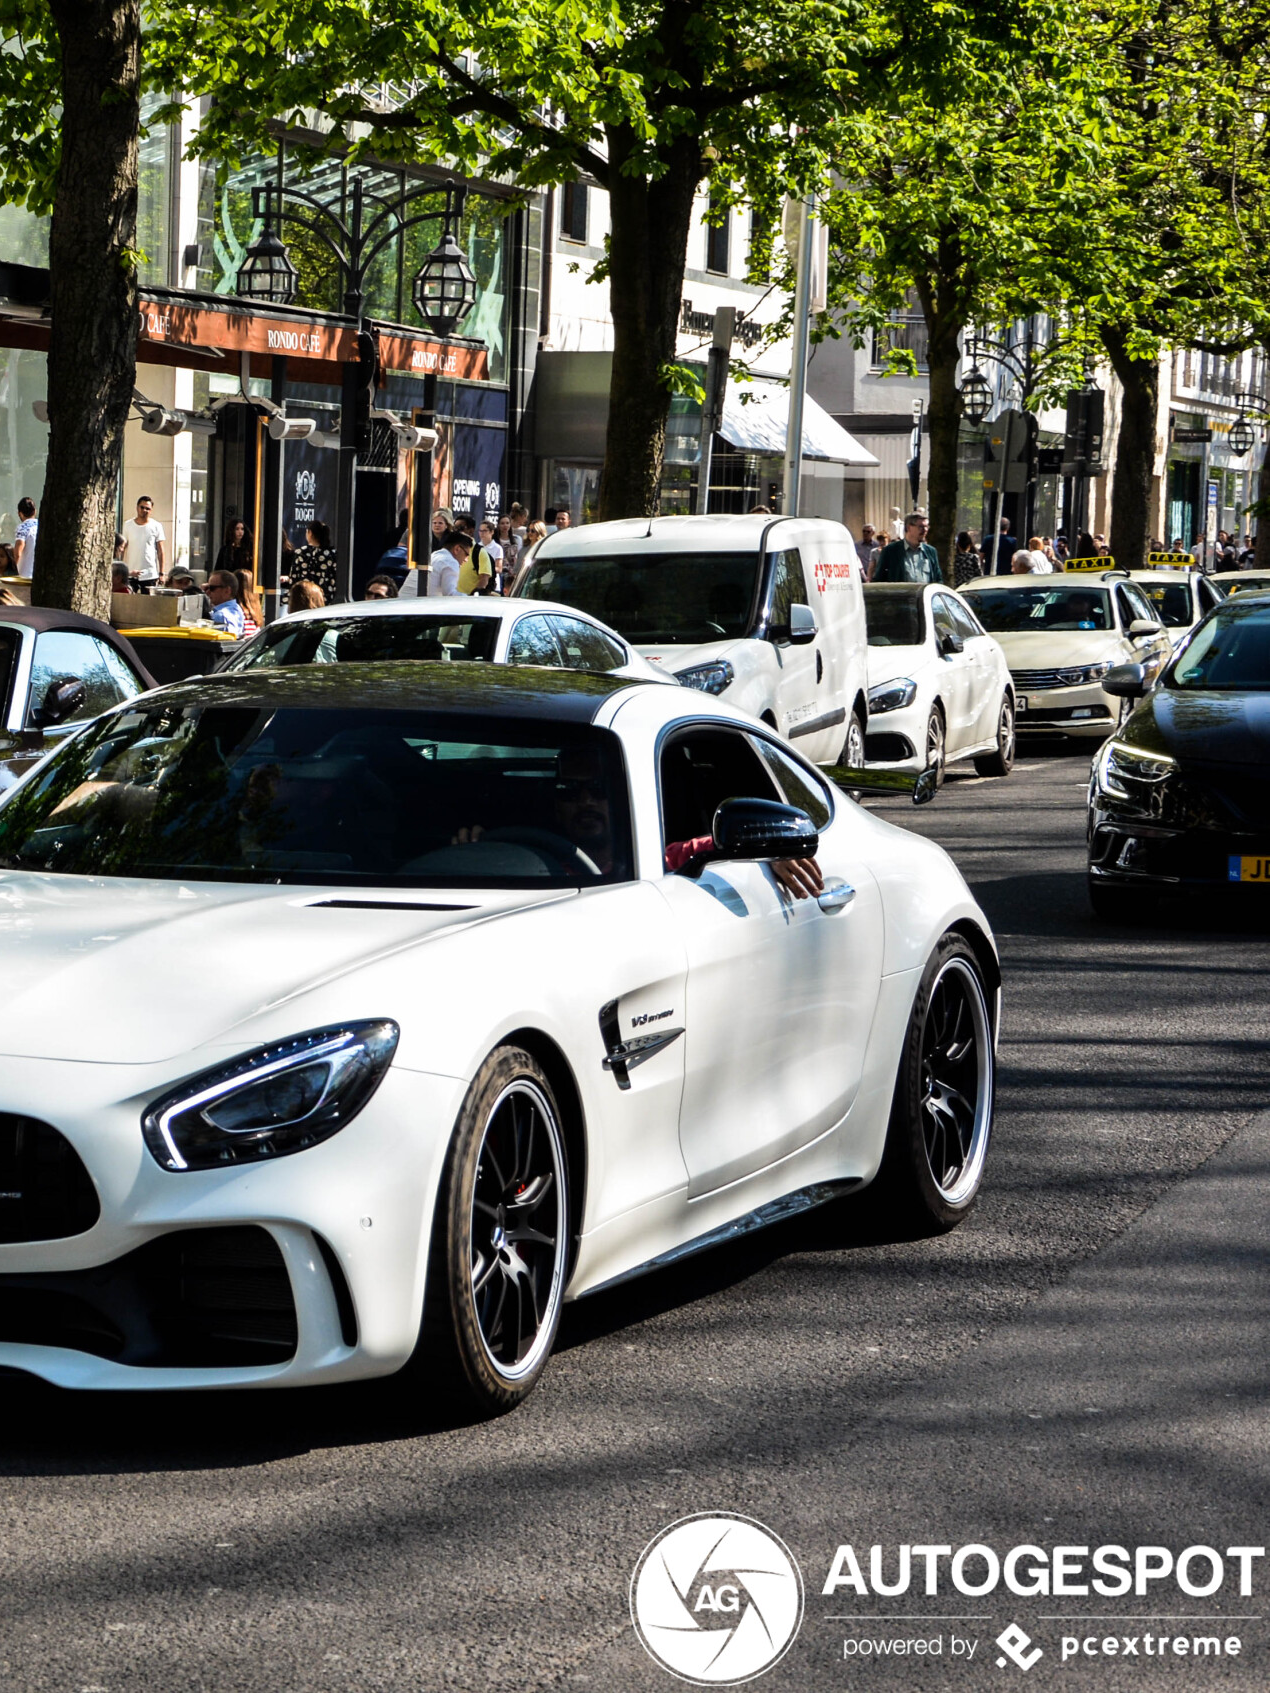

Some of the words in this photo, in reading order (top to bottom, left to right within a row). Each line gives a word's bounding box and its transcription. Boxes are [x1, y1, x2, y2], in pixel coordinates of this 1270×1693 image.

[146, 311, 171, 336] CAFÉ
[267, 329, 299, 350] RONDO
[299, 330, 321, 353] CAFÉ
[411, 350, 438, 370] RONDO
[438, 351, 457, 373] CAFÉ
[453, 478, 481, 497] OPENING
[452, 495, 471, 512] SOON
[1071, 559, 1106, 569] TAXI
[1155, 552, 1186, 563] TAXI
[631, 1013, 648, 1028] V8
